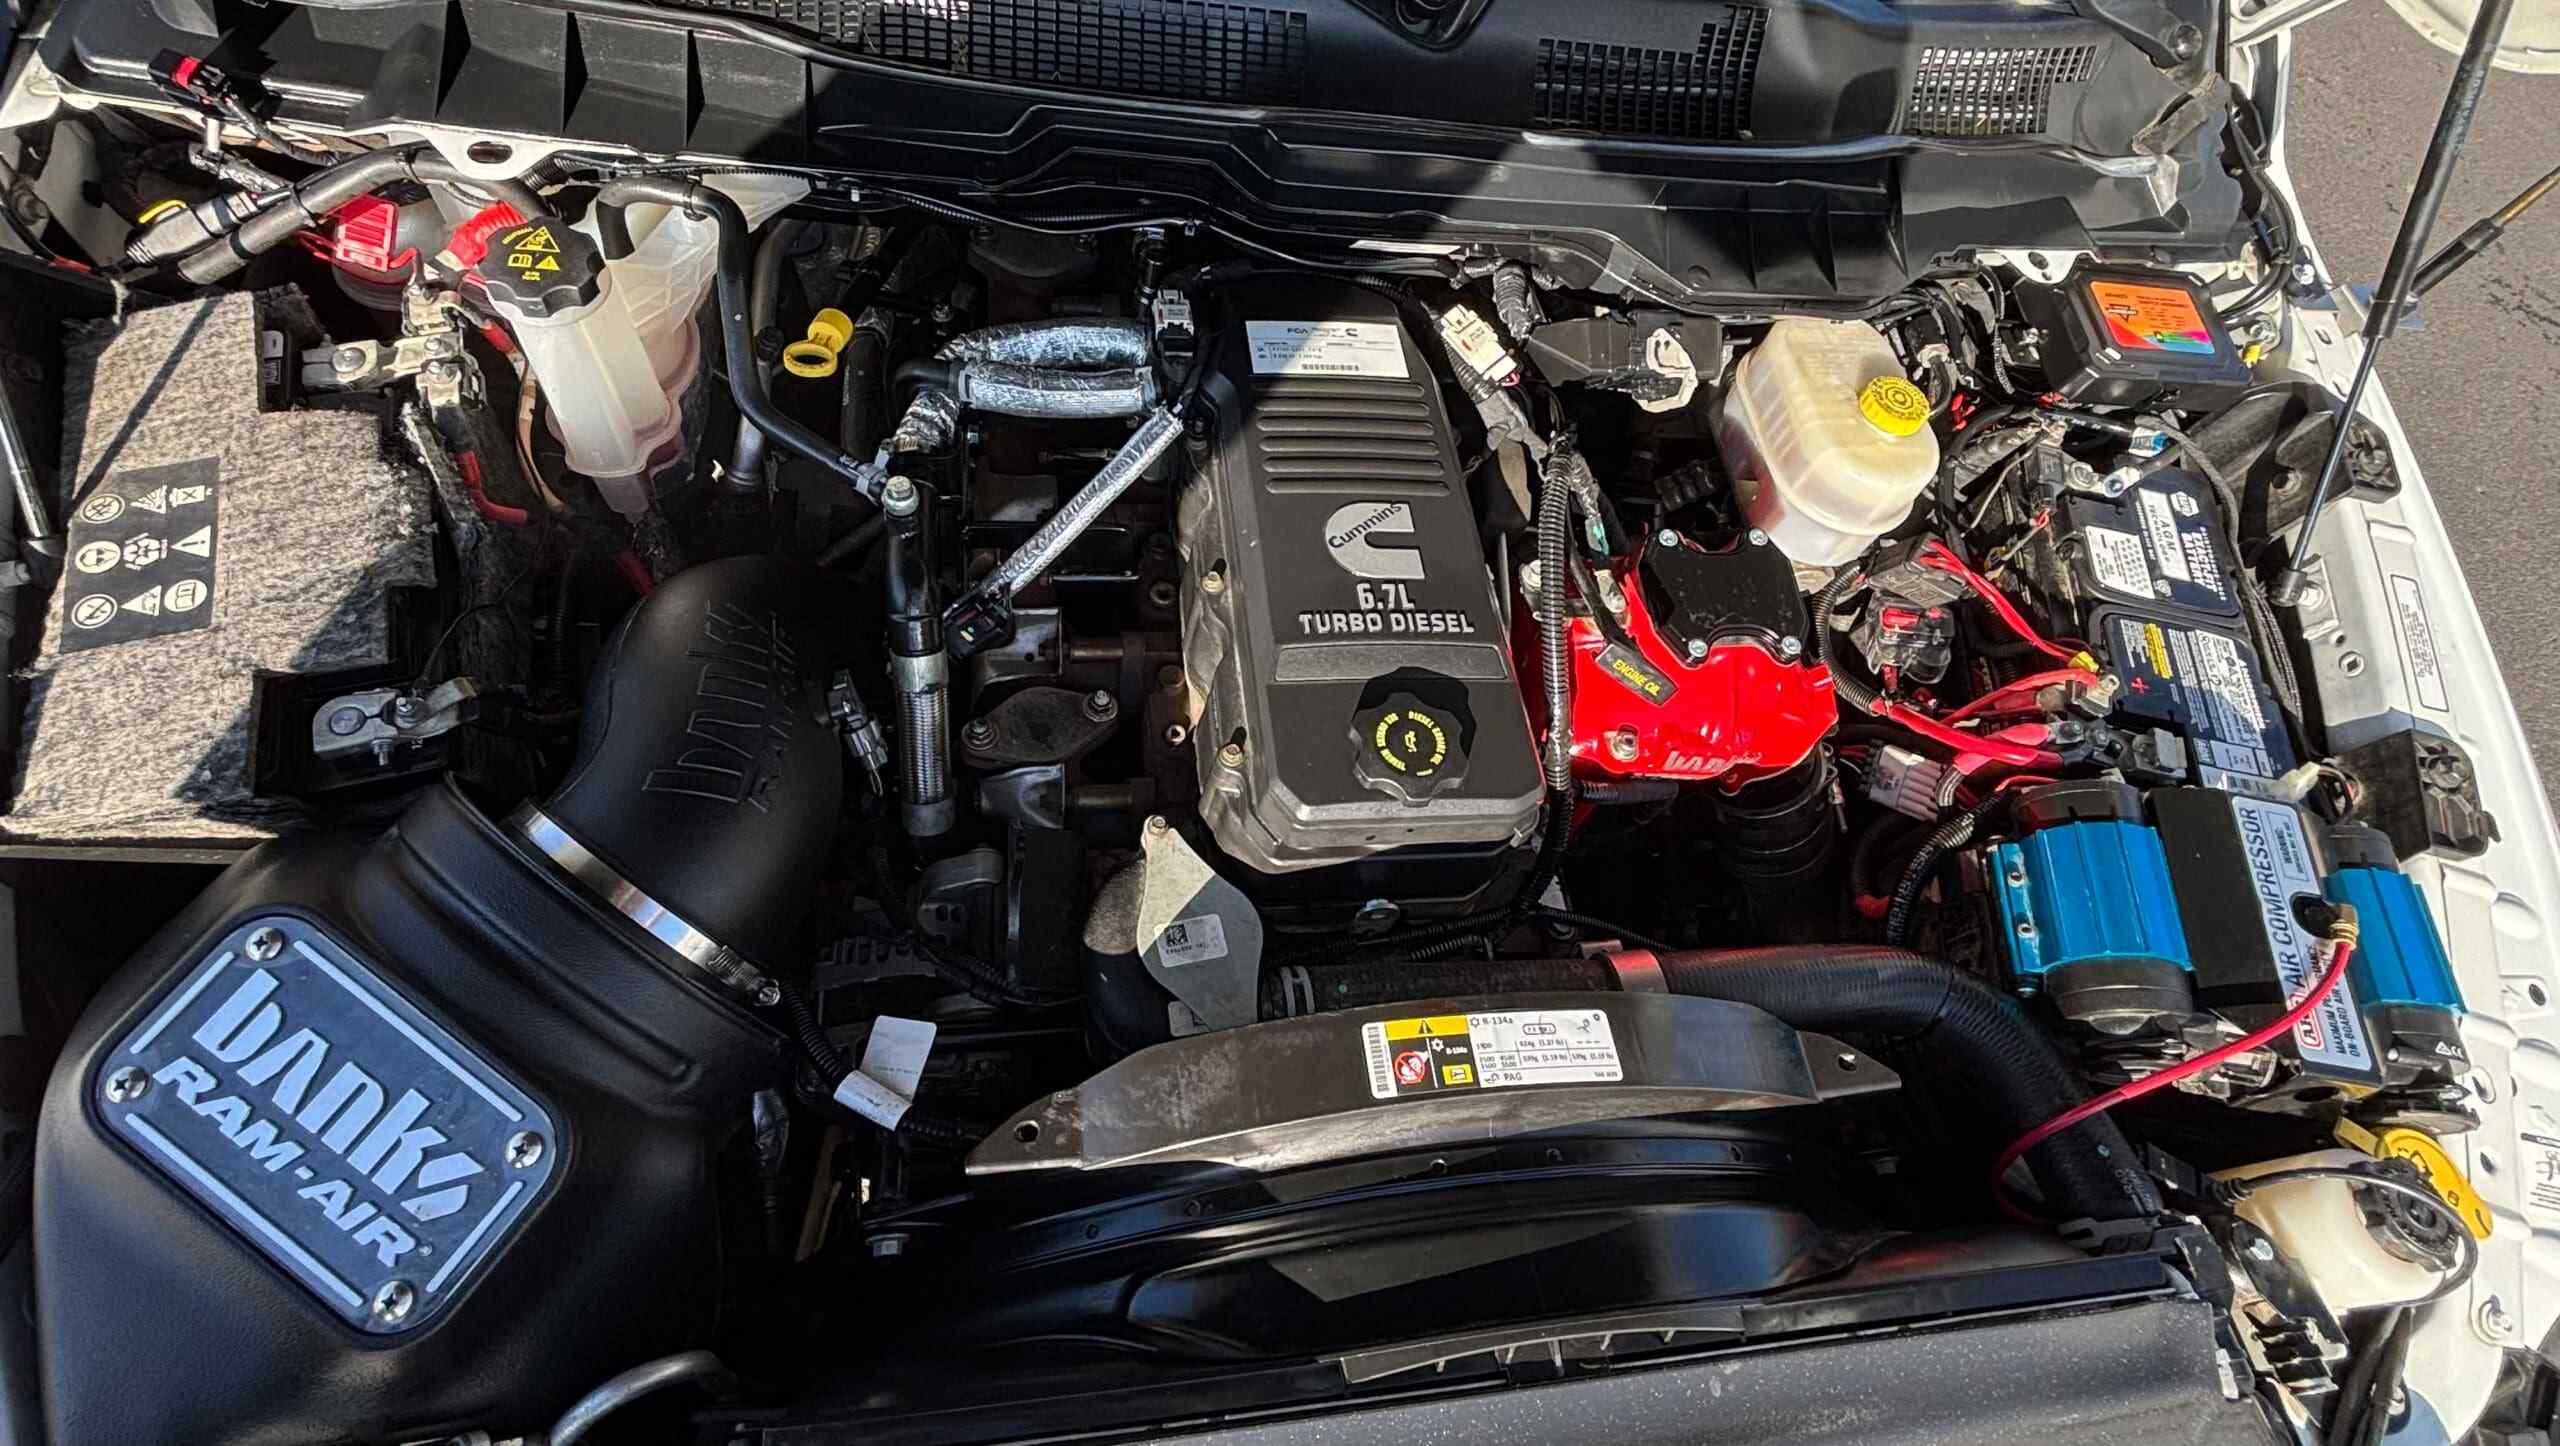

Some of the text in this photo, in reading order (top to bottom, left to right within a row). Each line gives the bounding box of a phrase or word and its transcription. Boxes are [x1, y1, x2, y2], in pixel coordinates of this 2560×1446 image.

[1328, 502, 1402, 549] Cummins
[1356, 582, 1415, 611] 6.7L
[1299, 612, 1475, 634] TURBO DIESEL
[1612, 658, 1662, 696] ENGINE OIL
[2240, 807, 2294, 946] COMPRESSOR
[2279, 947, 2304, 989] AIR
[2323, 1009, 2346, 1054] MAXIMUM
[152, 1056, 417, 1268] RAM-AIR
